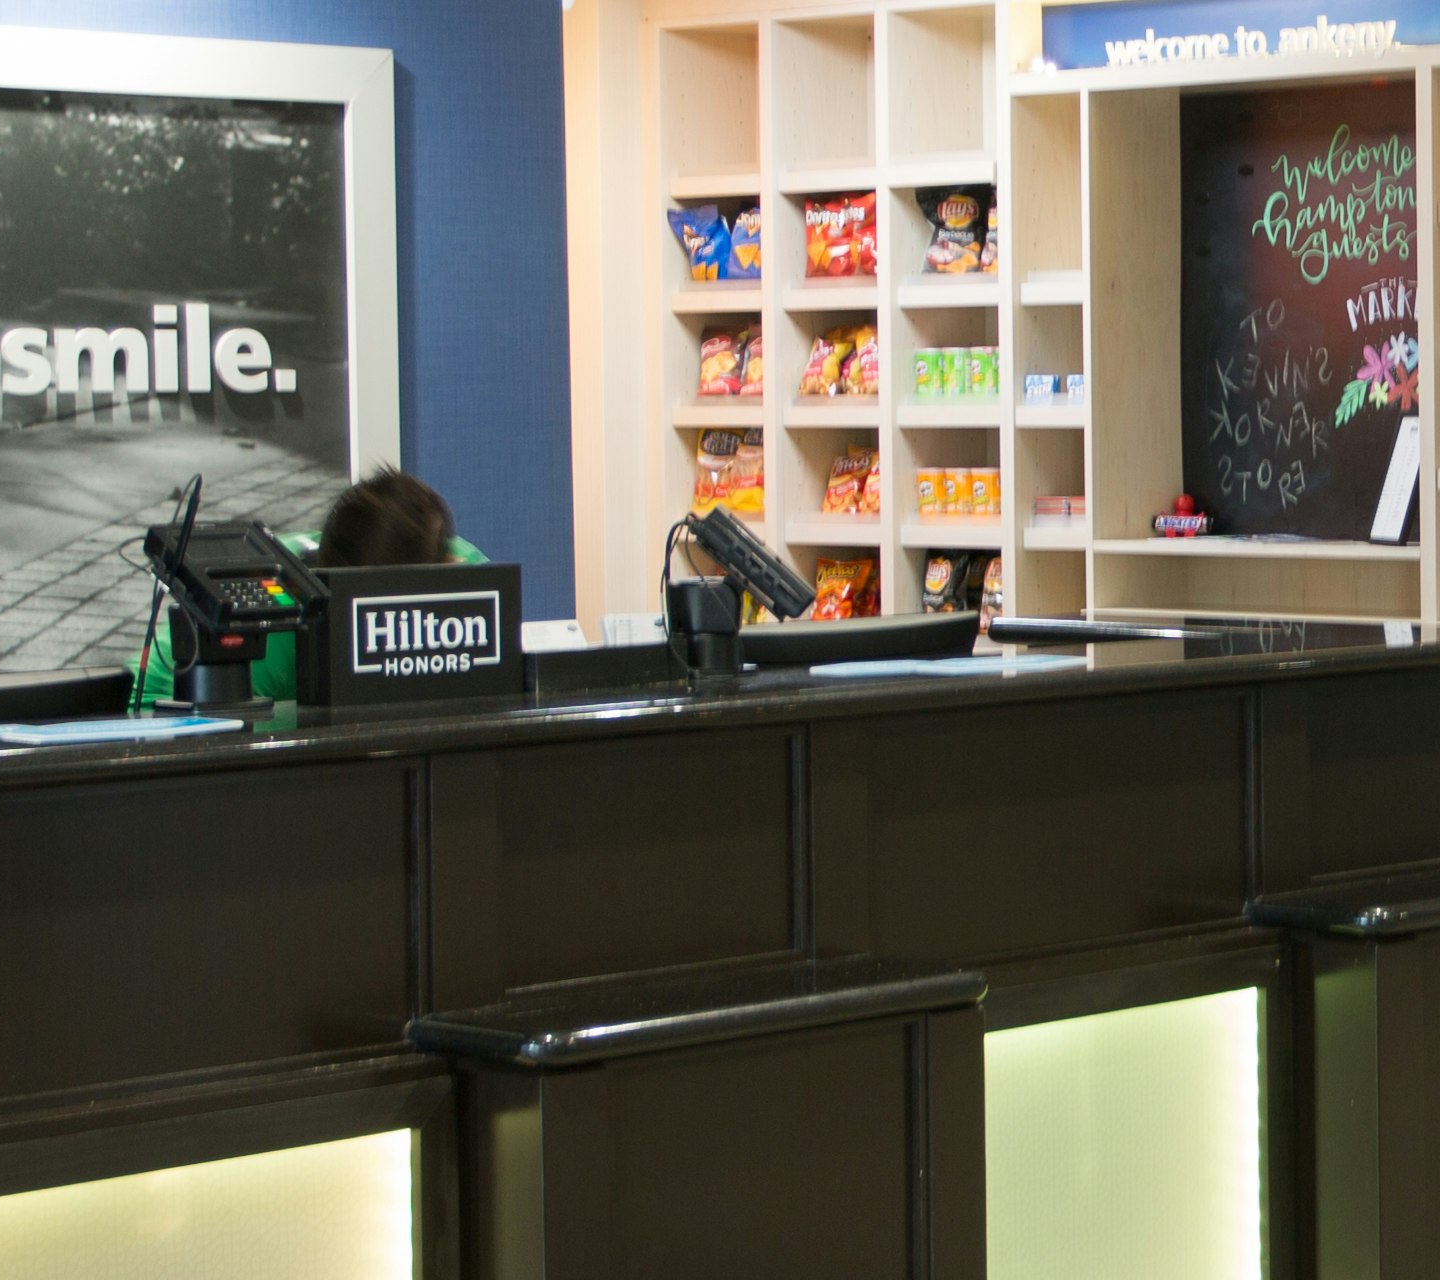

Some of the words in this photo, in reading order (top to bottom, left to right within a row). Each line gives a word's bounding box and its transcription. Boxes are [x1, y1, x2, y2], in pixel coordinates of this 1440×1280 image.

[1105, 28, 1229, 66] welcome
[1234, 25, 1266, 58] to
[1271, 123, 1417, 204] welcome
[1252, 170, 1417, 251] hampton
[1292, 214, 1417, 285] guests
[1346, 283, 1419, 332] MARK
[1, 303, 296, 396] smile.
[366, 610, 488, 653] Hilton
[386, 653, 471, 677] HONORS
